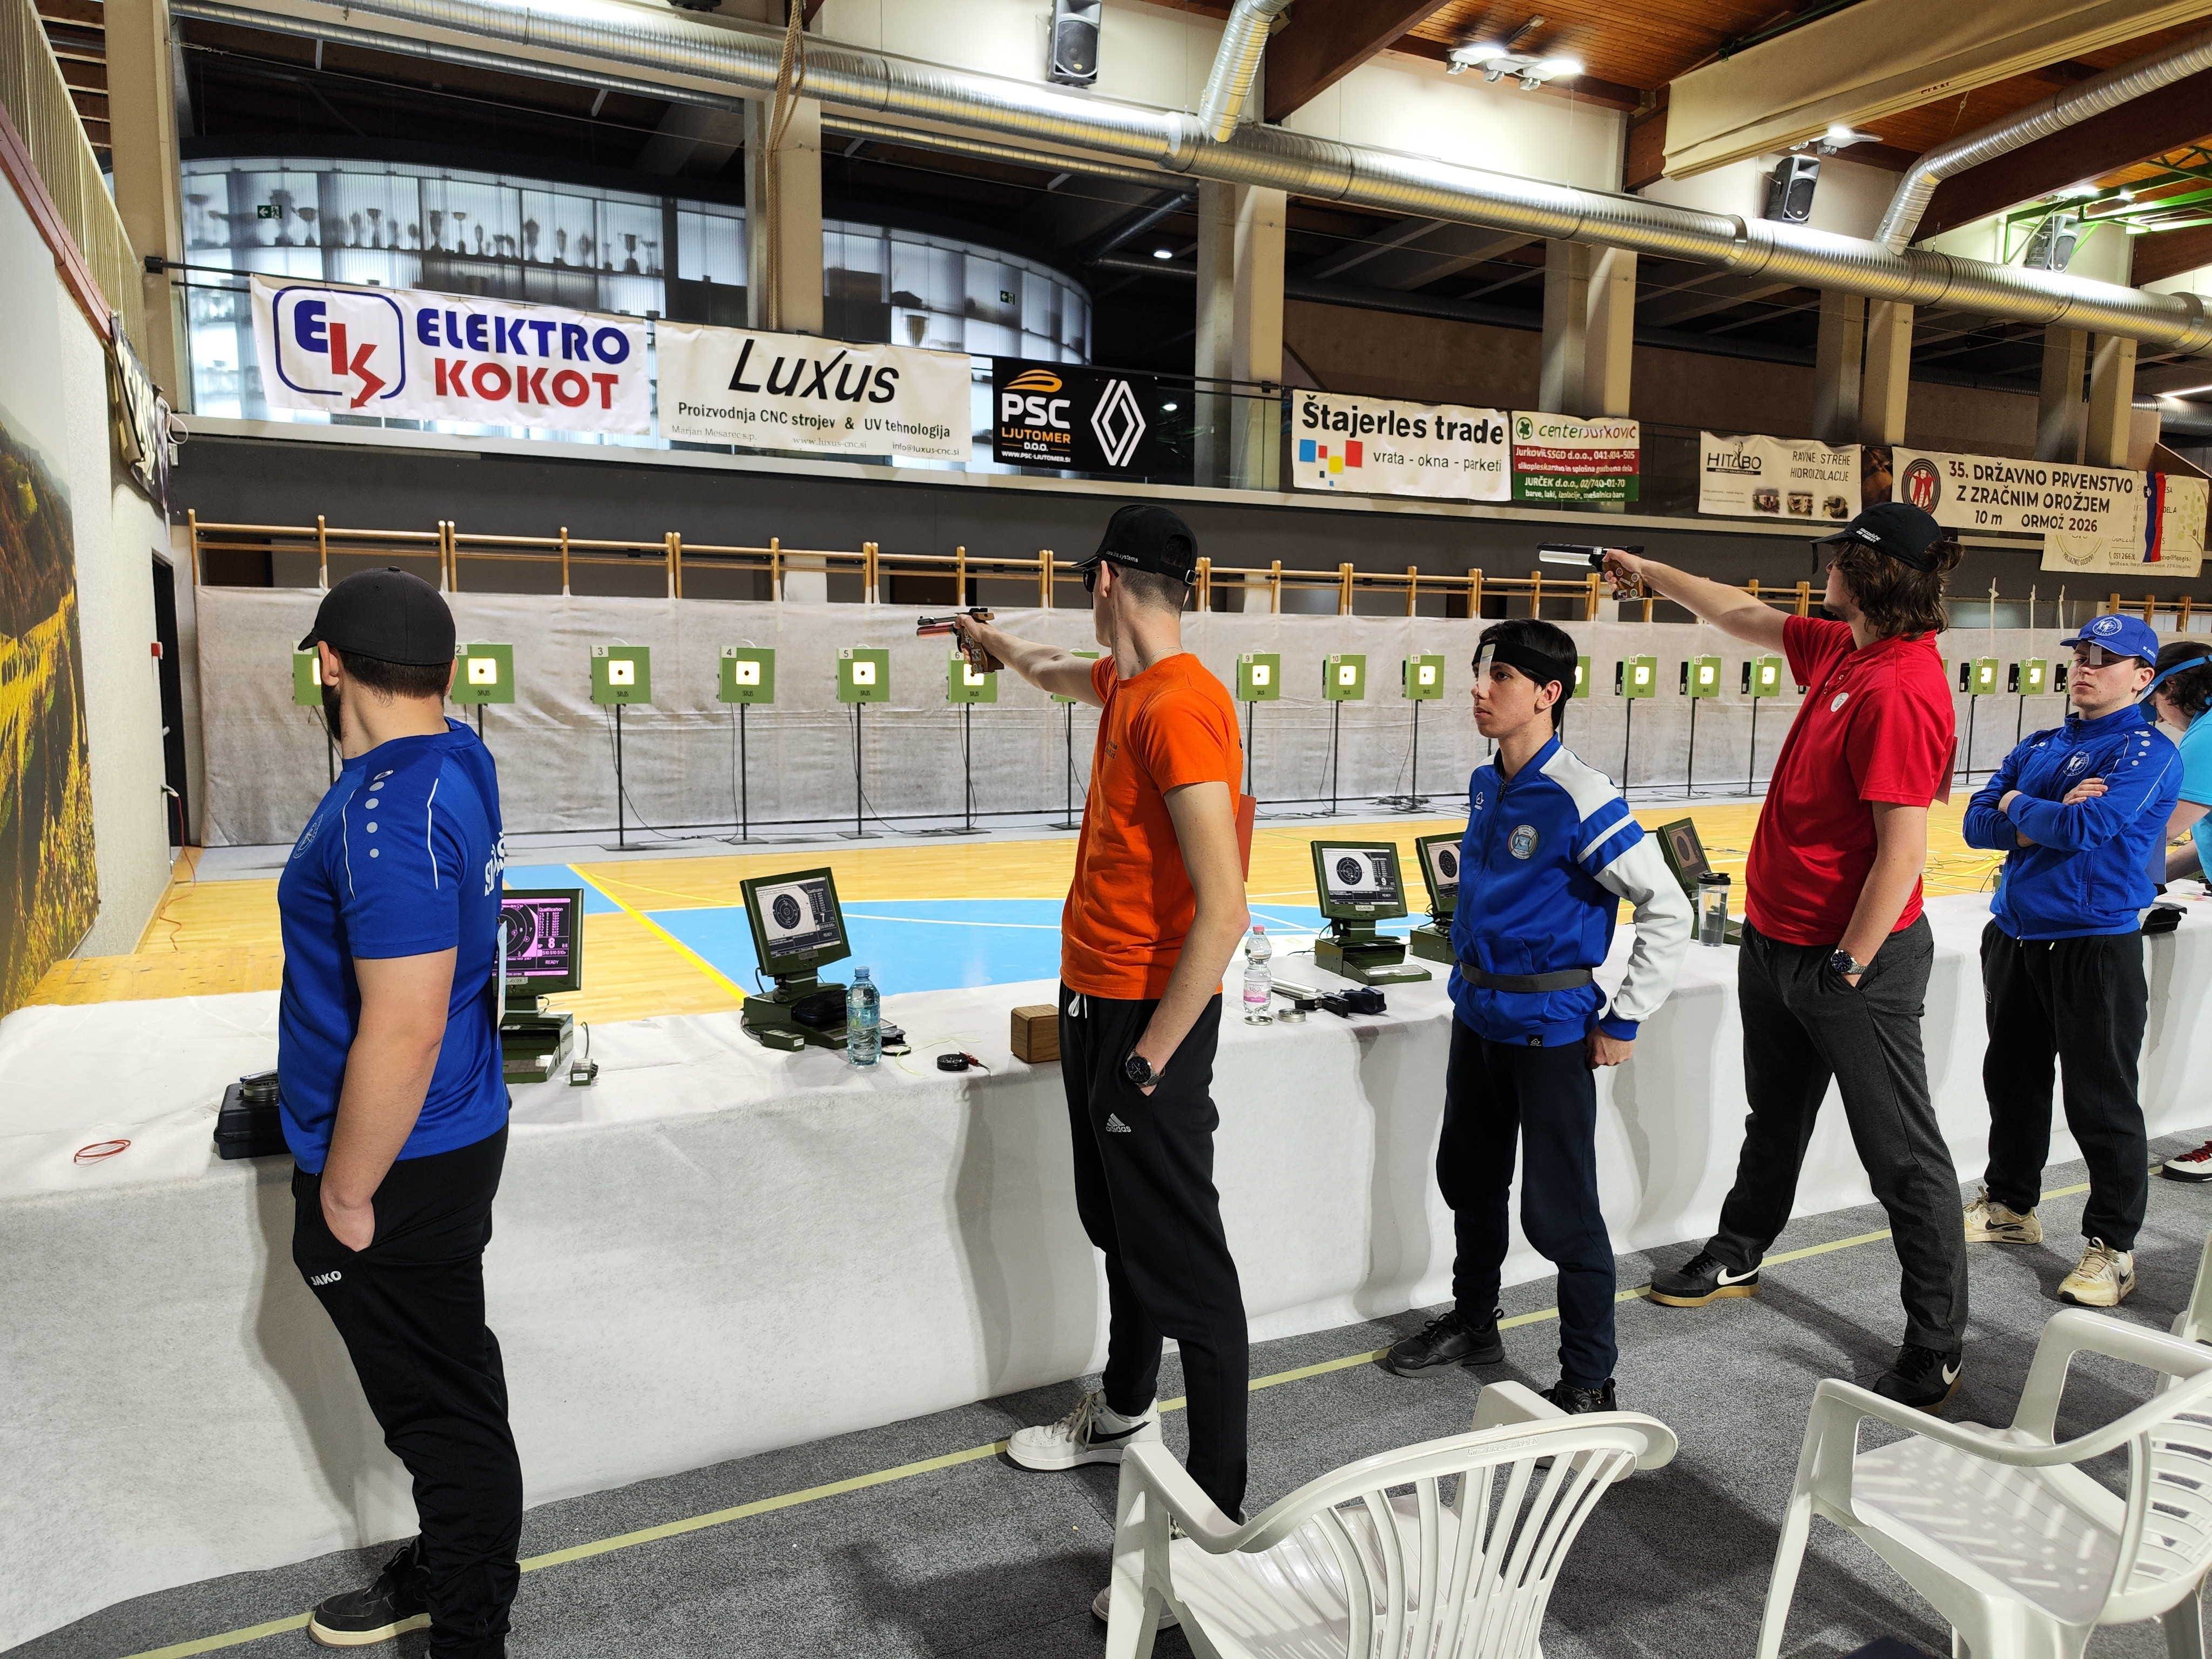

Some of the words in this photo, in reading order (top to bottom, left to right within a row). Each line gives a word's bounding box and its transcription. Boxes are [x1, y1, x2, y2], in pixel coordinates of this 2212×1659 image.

[417, 308, 630, 365] ELEKTRO
[728, 339, 899, 403] Luxus
[435, 358, 619, 409] KOKOT
[1002, 393, 1070, 429] PSC
[679, 402, 756, 423] Proizvodnja
[760, 410, 787, 424] CNC
[792, 414, 835, 429] strojev
[845, 417, 854, 429] &
[865, 419, 881, 430] UV
[886, 420, 950, 439] tehnologija
[1302, 394, 1427, 438] Štajerles
[1435, 416, 1503, 444] trade
[672, 425, 702, 439] Marjan
[742, 433, 757, 442] s.p.
[1002, 427, 1071, 444] LJUTOMER
[793, 437, 867, 449] www.luxus-cnc.si
[893, 442, 960, 456] info@luxus-cnc.si
[1023, 442, 1048, 451] D.O.O.
[1001, 450, 1071, 462] WWW.PSC-LJUTOMER.SI
[1373, 451, 1404, 465] vrata
[1418, 454, 1448, 468] okna
[1464, 458, 1501, 472] parketi
[1793, 451, 1816, 463] RAVNE
[1820, 454, 1851, 466] STREHE
[1525, 475, 1554, 487] JURČEK
[1790, 467, 1849, 482] HIDROIZOLACIJE
[1948, 461, 1968, 479] 35.
[1974, 462, 2047, 486] DRŽAVNO
[2052, 471, 2133, 494] PRVENSTVO
[1956, 485, 1967, 502] Z
[1971, 485, 2038, 508] ZRAČNIM
[2042, 491, 2110, 514] OROŽJEM
[1975, 510, 1987, 525] 10
[1991, 514, 2002, 525] m
[2021, 512, 2063, 530] ORMOŽ
[2069, 517, 2098, 532] 2026
[456, 645, 462, 654] 2
[598, 647, 603, 656] 3
[726, 648, 732, 656] 4
[844, 650, 849, 658] 5
[1381, 877, 1387, 886] 9
[820, 913, 825, 923] 7
[548, 937, 555, 948] 8
[1105, 1125, 1131, 1133] adidas
[310, 1270, 342, 1286] JAKO
[1486, 1437, 1539, 1453] PROGARDEN
